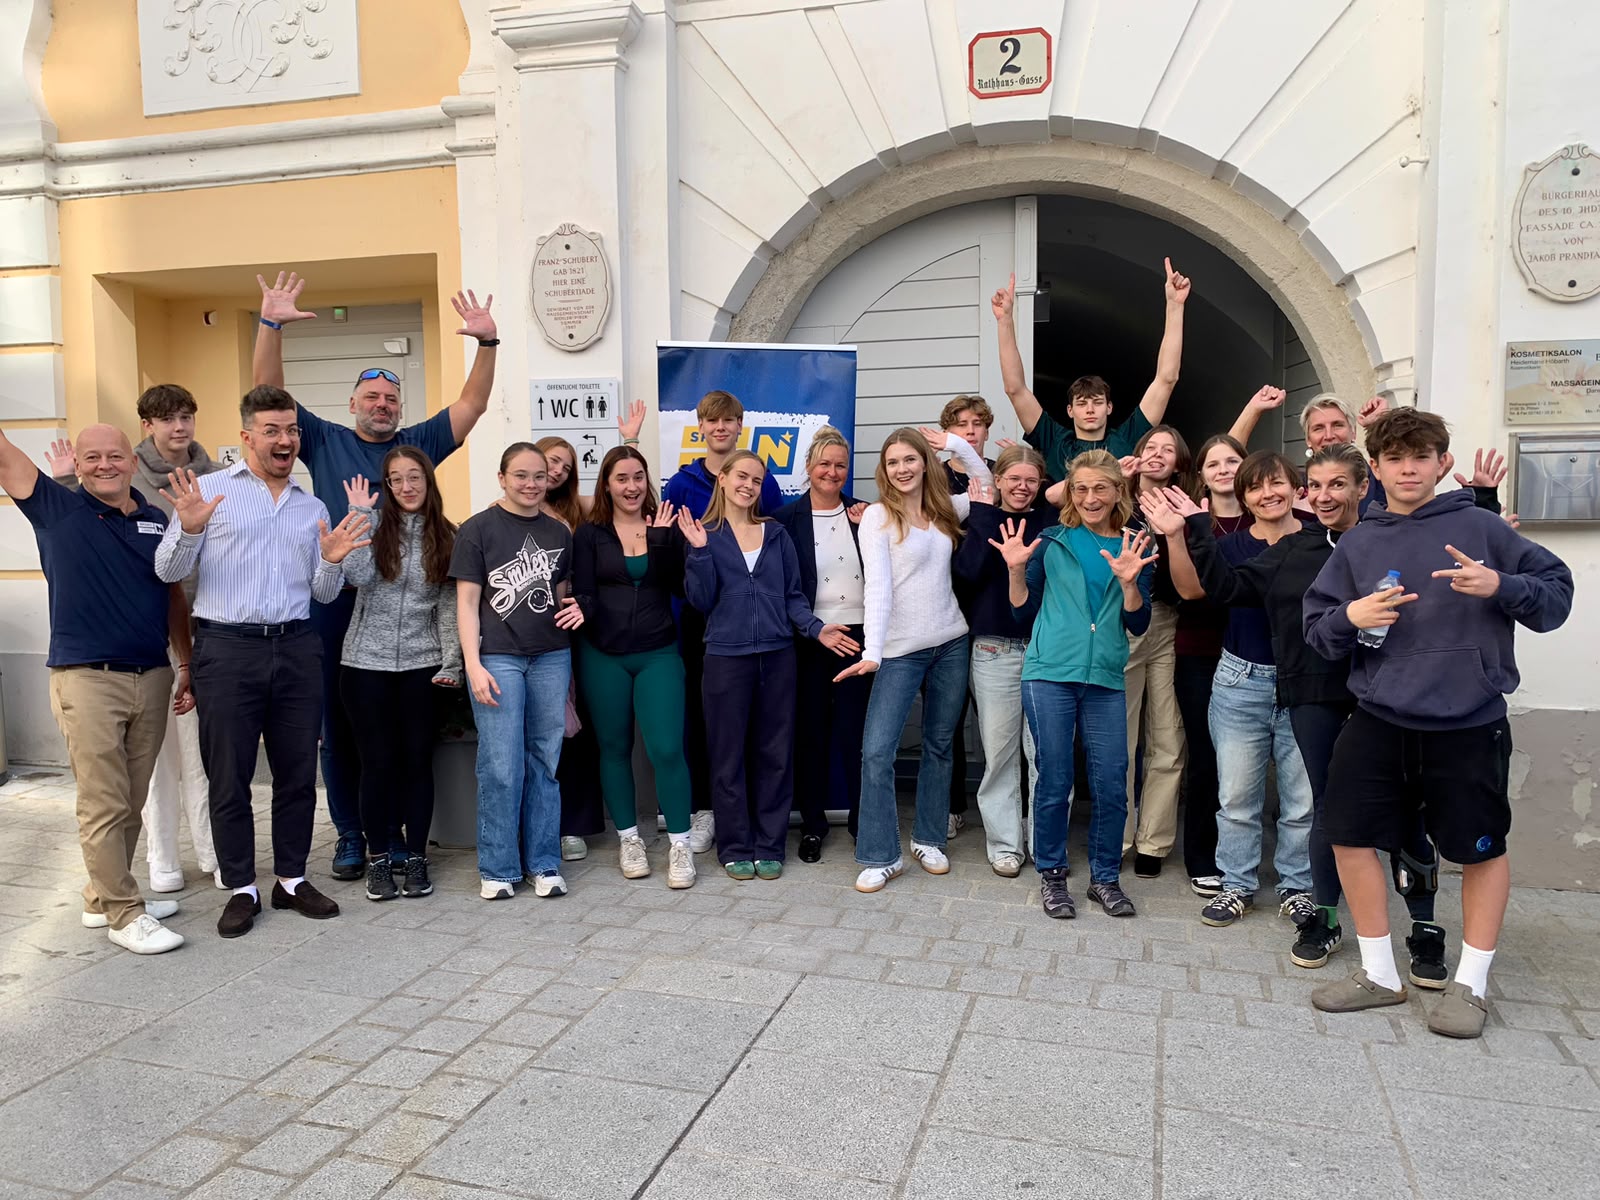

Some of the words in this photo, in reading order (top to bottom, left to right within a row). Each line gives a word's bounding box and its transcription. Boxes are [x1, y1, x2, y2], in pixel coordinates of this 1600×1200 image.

[999, 37, 1022, 76] 2
[1538, 207, 1558, 217] DES
[1526, 221, 1574, 232] FASSADE
[1563, 237, 1584, 246] VON
[538, 258, 560, 266] FRANZ
[562, 255, 598, 265] SCHUBERT
[1527, 253, 1556, 263] JAKOB
[553, 268, 568, 276] GAB
[569, 267, 585, 275] 1821
[552, 279, 568, 287] HIER
[570, 277, 586, 285] EINE
[544, 287, 596, 298] SCHUBERTIADE
[1510, 349, 1582, 359] KOSMETIKSALON
[546, 383, 578, 391] ÖFFENTLICHE
[550, 398, 579, 418] WC
[488, 548, 552, 614] Smiley
